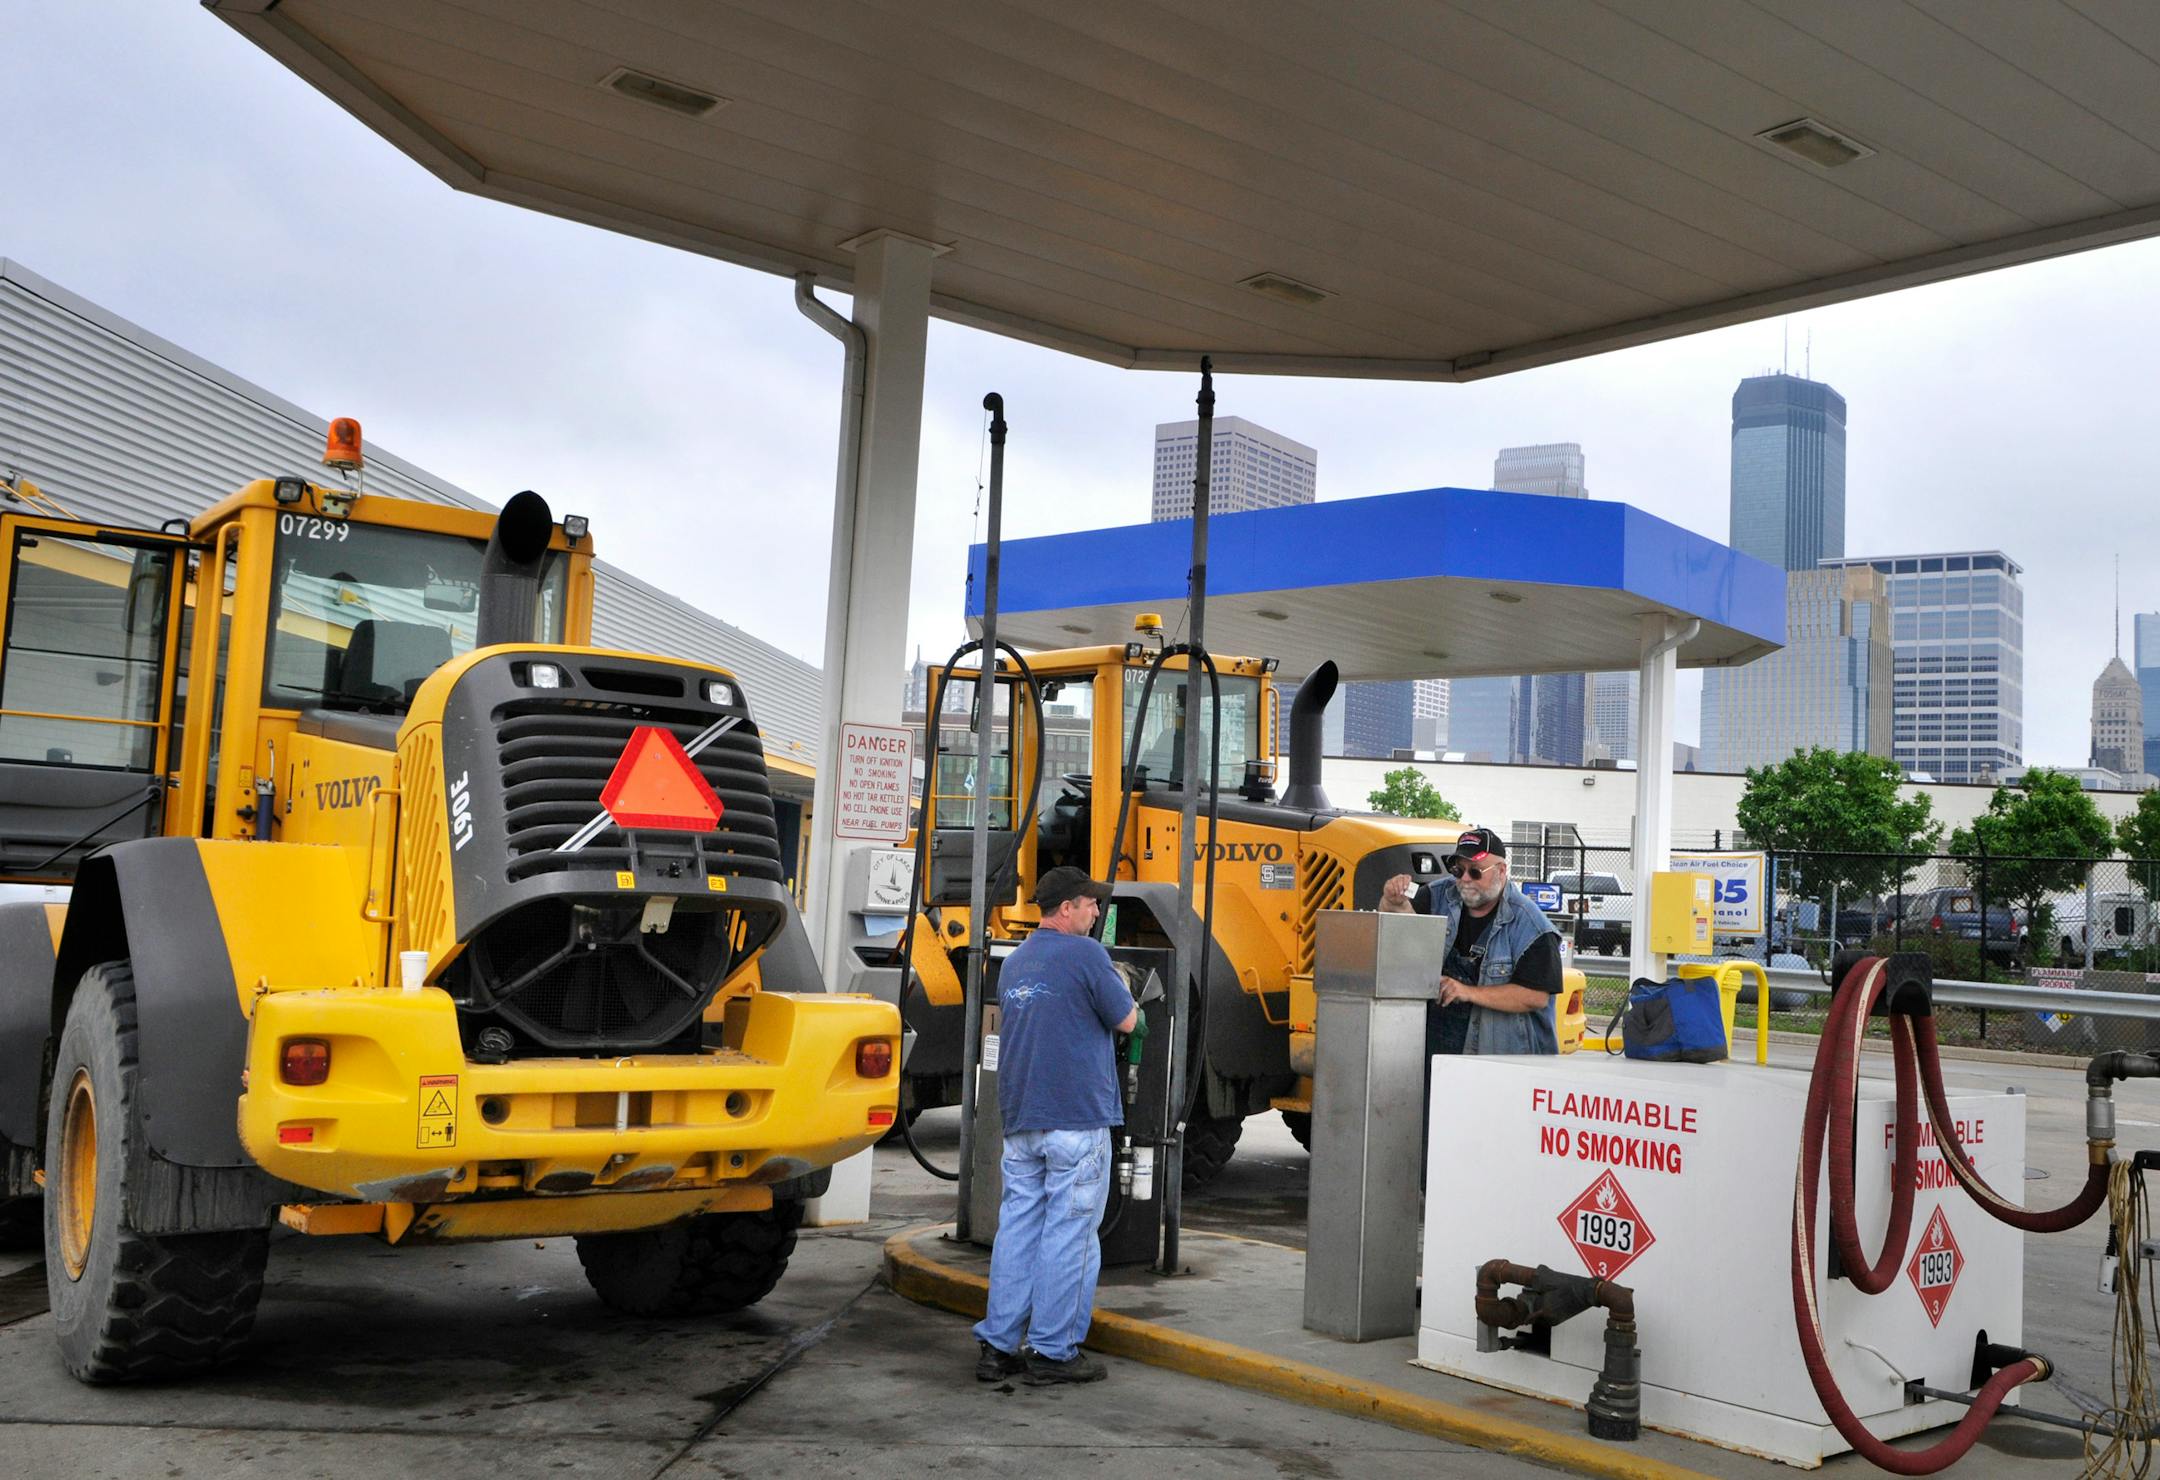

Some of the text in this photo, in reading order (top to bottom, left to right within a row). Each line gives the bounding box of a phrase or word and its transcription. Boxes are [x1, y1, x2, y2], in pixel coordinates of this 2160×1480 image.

[280, 513, 349, 543] 07299
[1124, 668, 1157, 686] 072
[847, 734, 907, 753] DANGER
[849, 754, 903, 768] TURN OFF IGNITION
[854, 767, 897, 779] NO SMOKING
[315, 775, 381, 811] VOLVO
[849, 779, 900, 791] NO OPEN FLAMES
[843, 791, 905, 804] NO HOT TAR KETTLES
[450, 770, 473, 851] L90E
[843, 803, 903, 816] NO CELL PHONE USE
[841, 818, 903, 830] NEAR FUEL PUMPS
[873, 857, 885, 871] CITY
[895, 855, 913, 874] LAKES
[1702, 860, 1719, 868] Fuel
[1720, 860, 1748, 869] Choice
[2032, 968, 2083, 978] FLAMMABLE
[1532, 1087, 1698, 1134] FLAMMABLE
[1540, 1126, 1682, 1174] NO SMOKING
[1580, 1213, 1632, 1252] 1993
[1597, 1261, 1608, 1277] 3
[1921, 1252, 1952, 1286] 1993
[1932, 1300, 1940, 1316] 3
